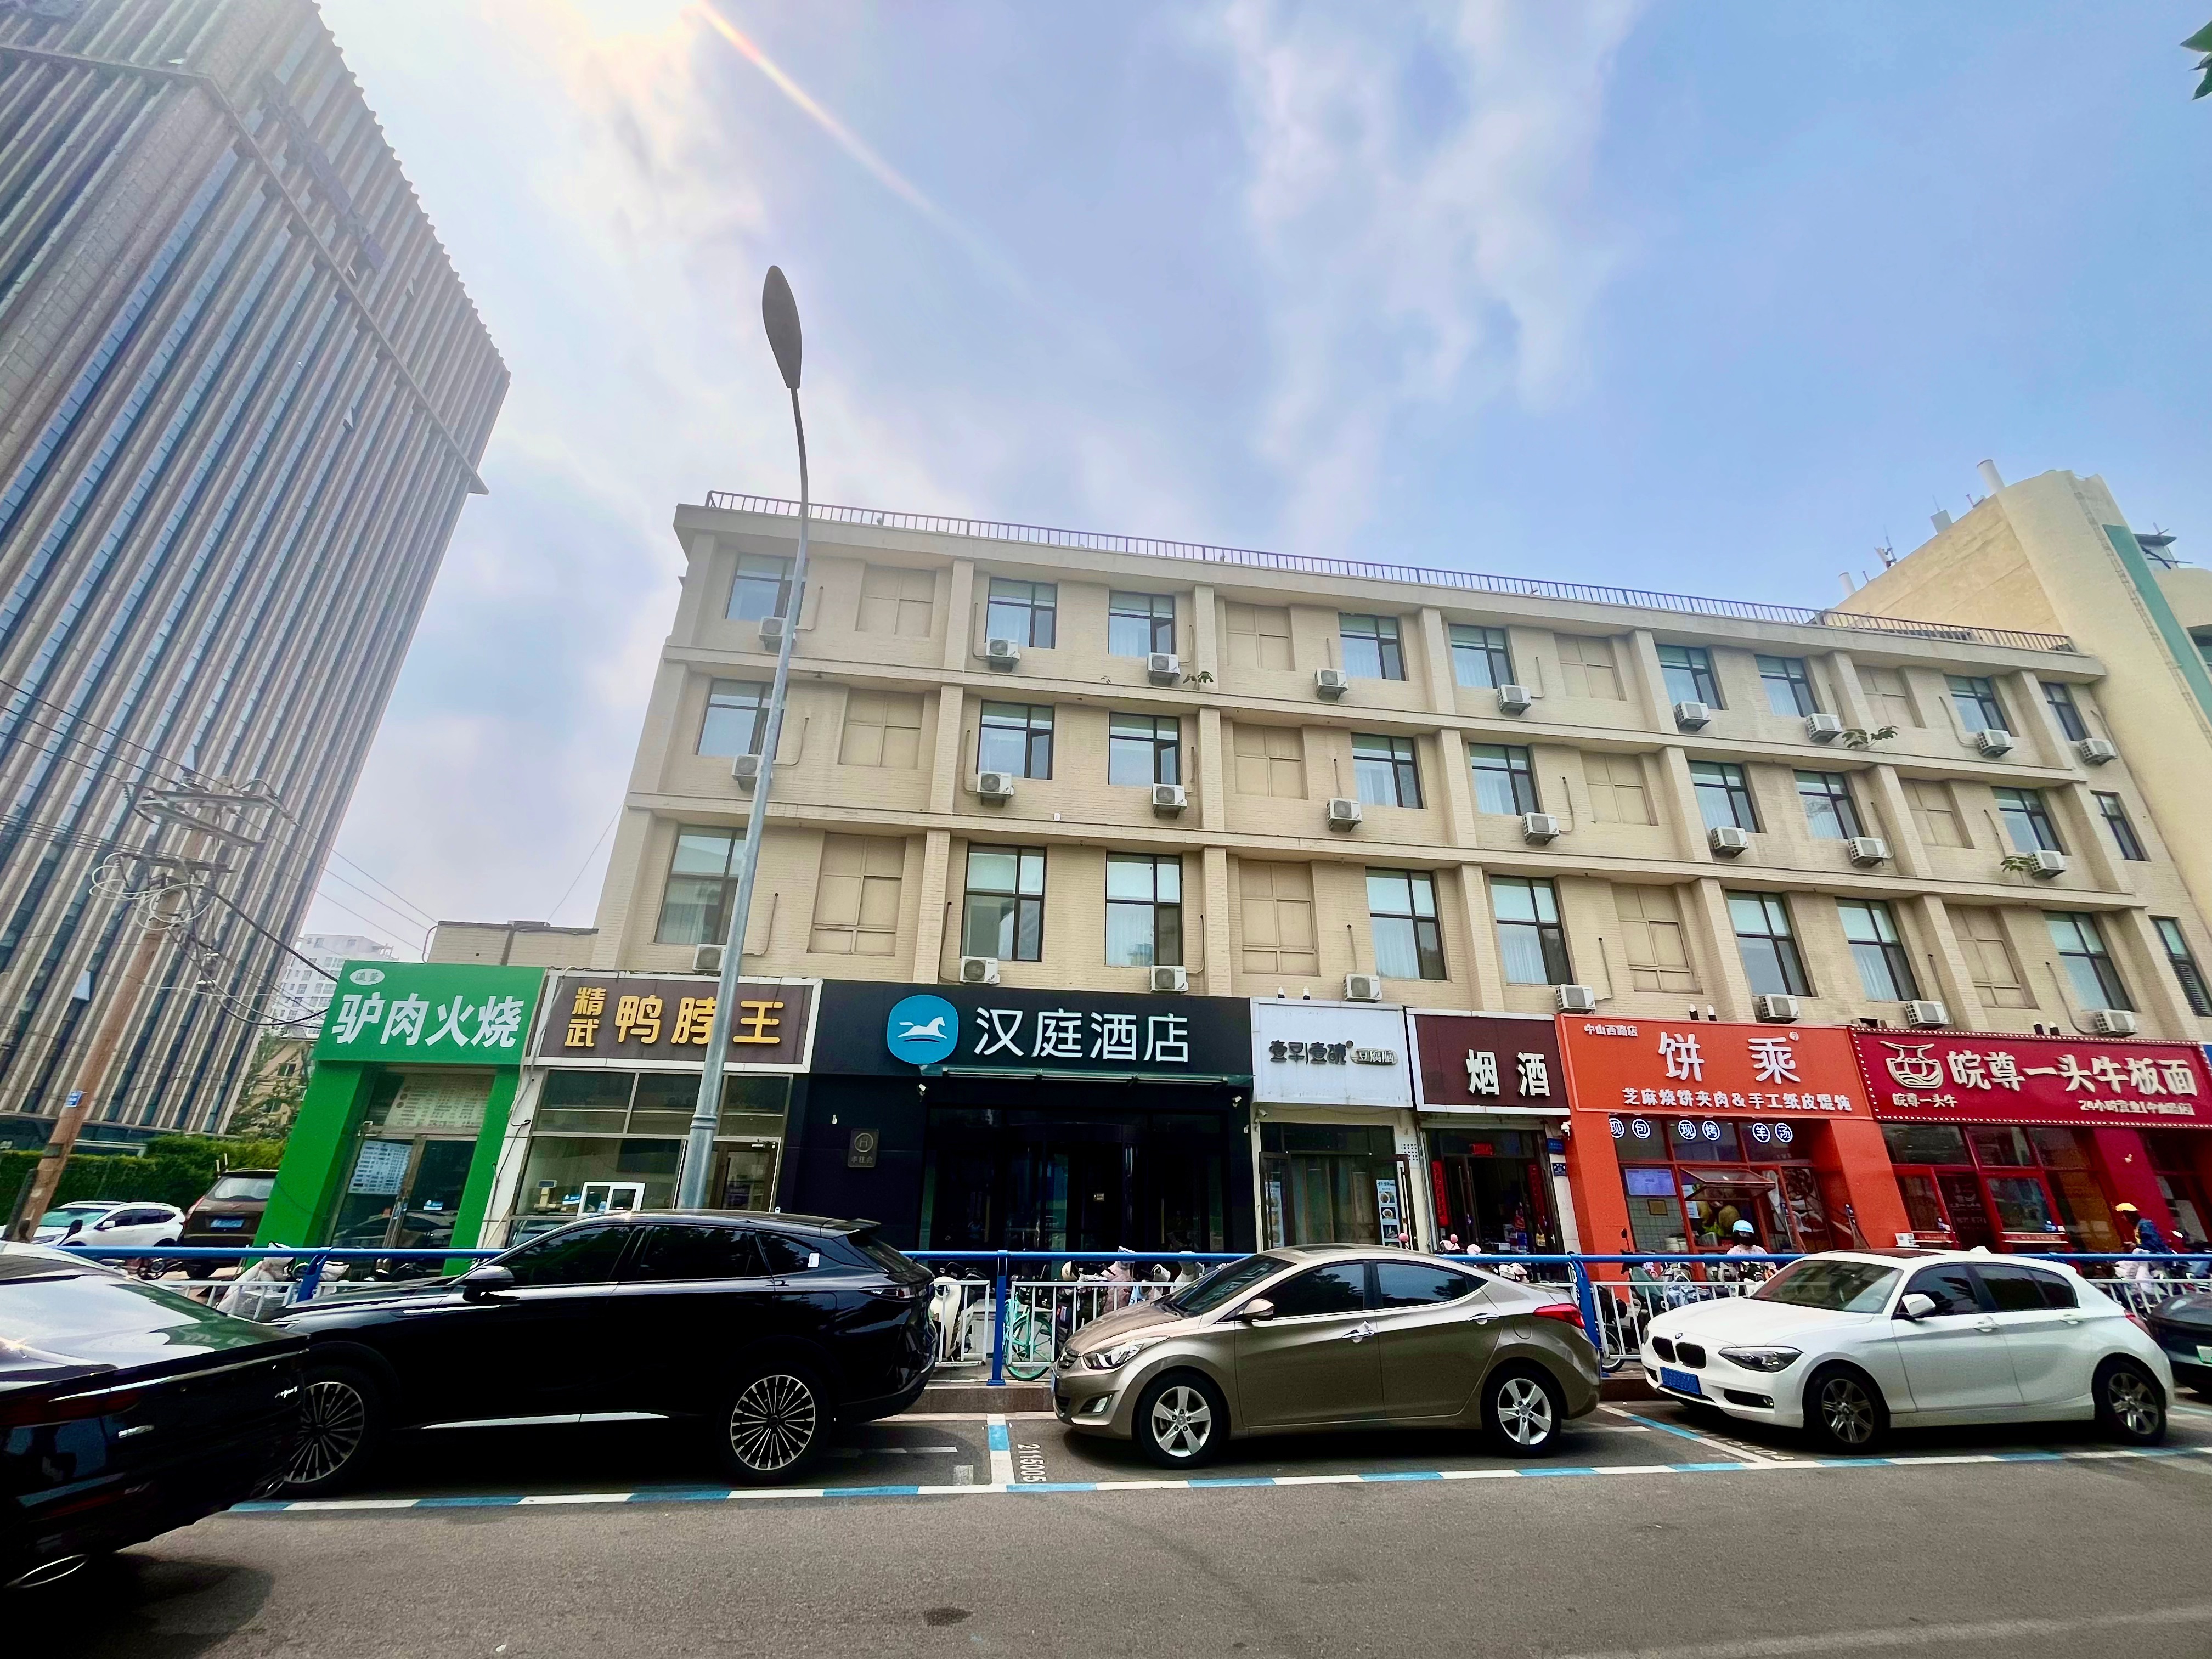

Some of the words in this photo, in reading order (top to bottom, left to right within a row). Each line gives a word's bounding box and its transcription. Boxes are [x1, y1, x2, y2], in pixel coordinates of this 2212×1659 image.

[331, 992, 524, 1047] 驴肉火烧
[565, 987, 606, 1047] 精武
[615, 995, 784, 1044] 鸭脖王
[974, 1007, 1188, 1062] 汉庭酒店
[1584, 1023, 1638, 1037] 中山西路店
[1466, 1049, 1550, 1096] 烟酒
[1658, 1031, 1801, 1084] 饼乘
[1946, 1049, 2198, 1096] 皖尊一头牛板面
[1892, 1093, 1958, 1108] 皖尊一头牛
[1754, 1125, 1791, 1141] 羊汤
[1017, 1442, 1047, 1482] 2115005
